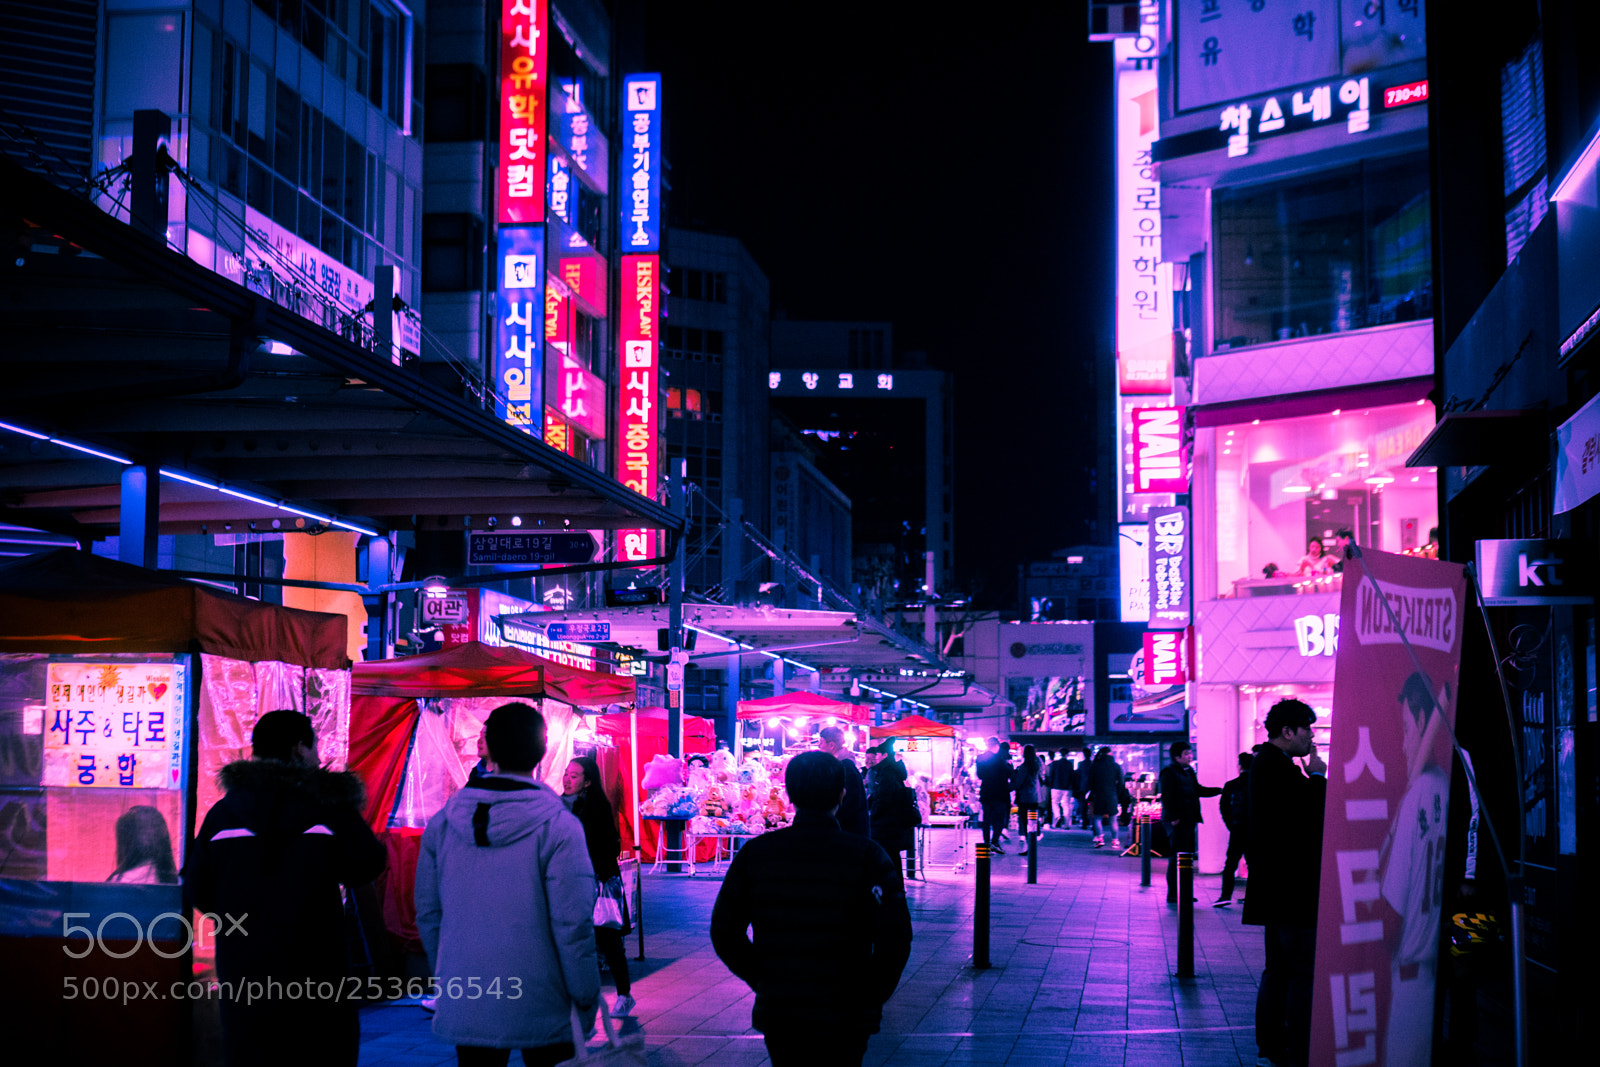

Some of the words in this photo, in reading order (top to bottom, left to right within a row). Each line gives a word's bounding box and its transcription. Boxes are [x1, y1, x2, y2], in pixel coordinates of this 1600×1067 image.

[632, 113, 650, 246] 공부기술연구소
[1138, 409, 1181, 490] NAIL
[474, 536, 552, 551] 삼일대로19길
[1154, 512, 1184, 555] BR
[473, 552, 527, 562] Samil-daero
[530, 552, 555, 563] 19-gil
[1518, 552, 1563, 587] kt
[427, 600, 463, 617] 여관
[1152, 633, 1177, 684] NAIL
[50, 709, 96, 746] 사주
[122, 711, 165, 747] 타로
